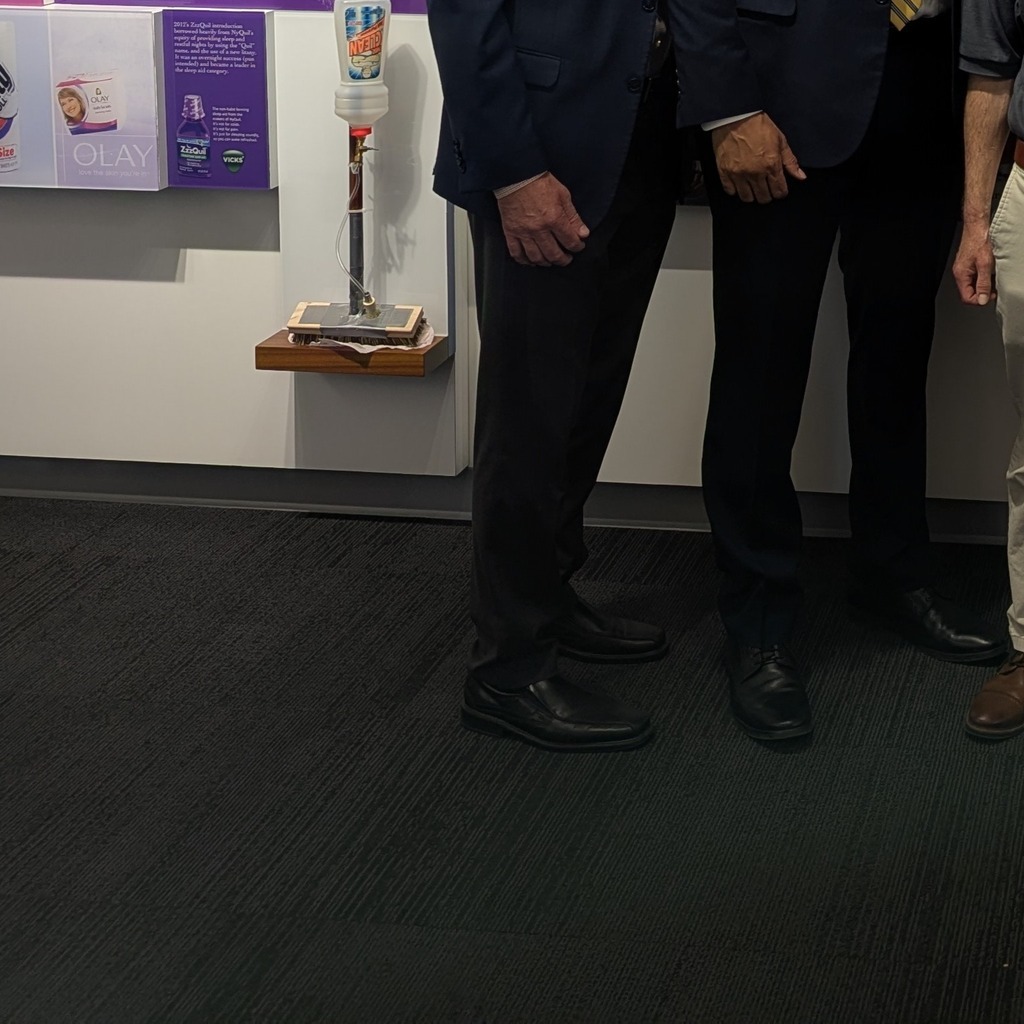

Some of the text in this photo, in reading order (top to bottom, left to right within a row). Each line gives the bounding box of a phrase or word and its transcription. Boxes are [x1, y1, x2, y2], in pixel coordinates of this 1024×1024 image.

[349, 31, 382, 57] CLEAN
[91, 95, 109, 103] OLAY
[73, 142, 153, 167] OLAY
[180, 145, 207, 155] ZzzQuil
